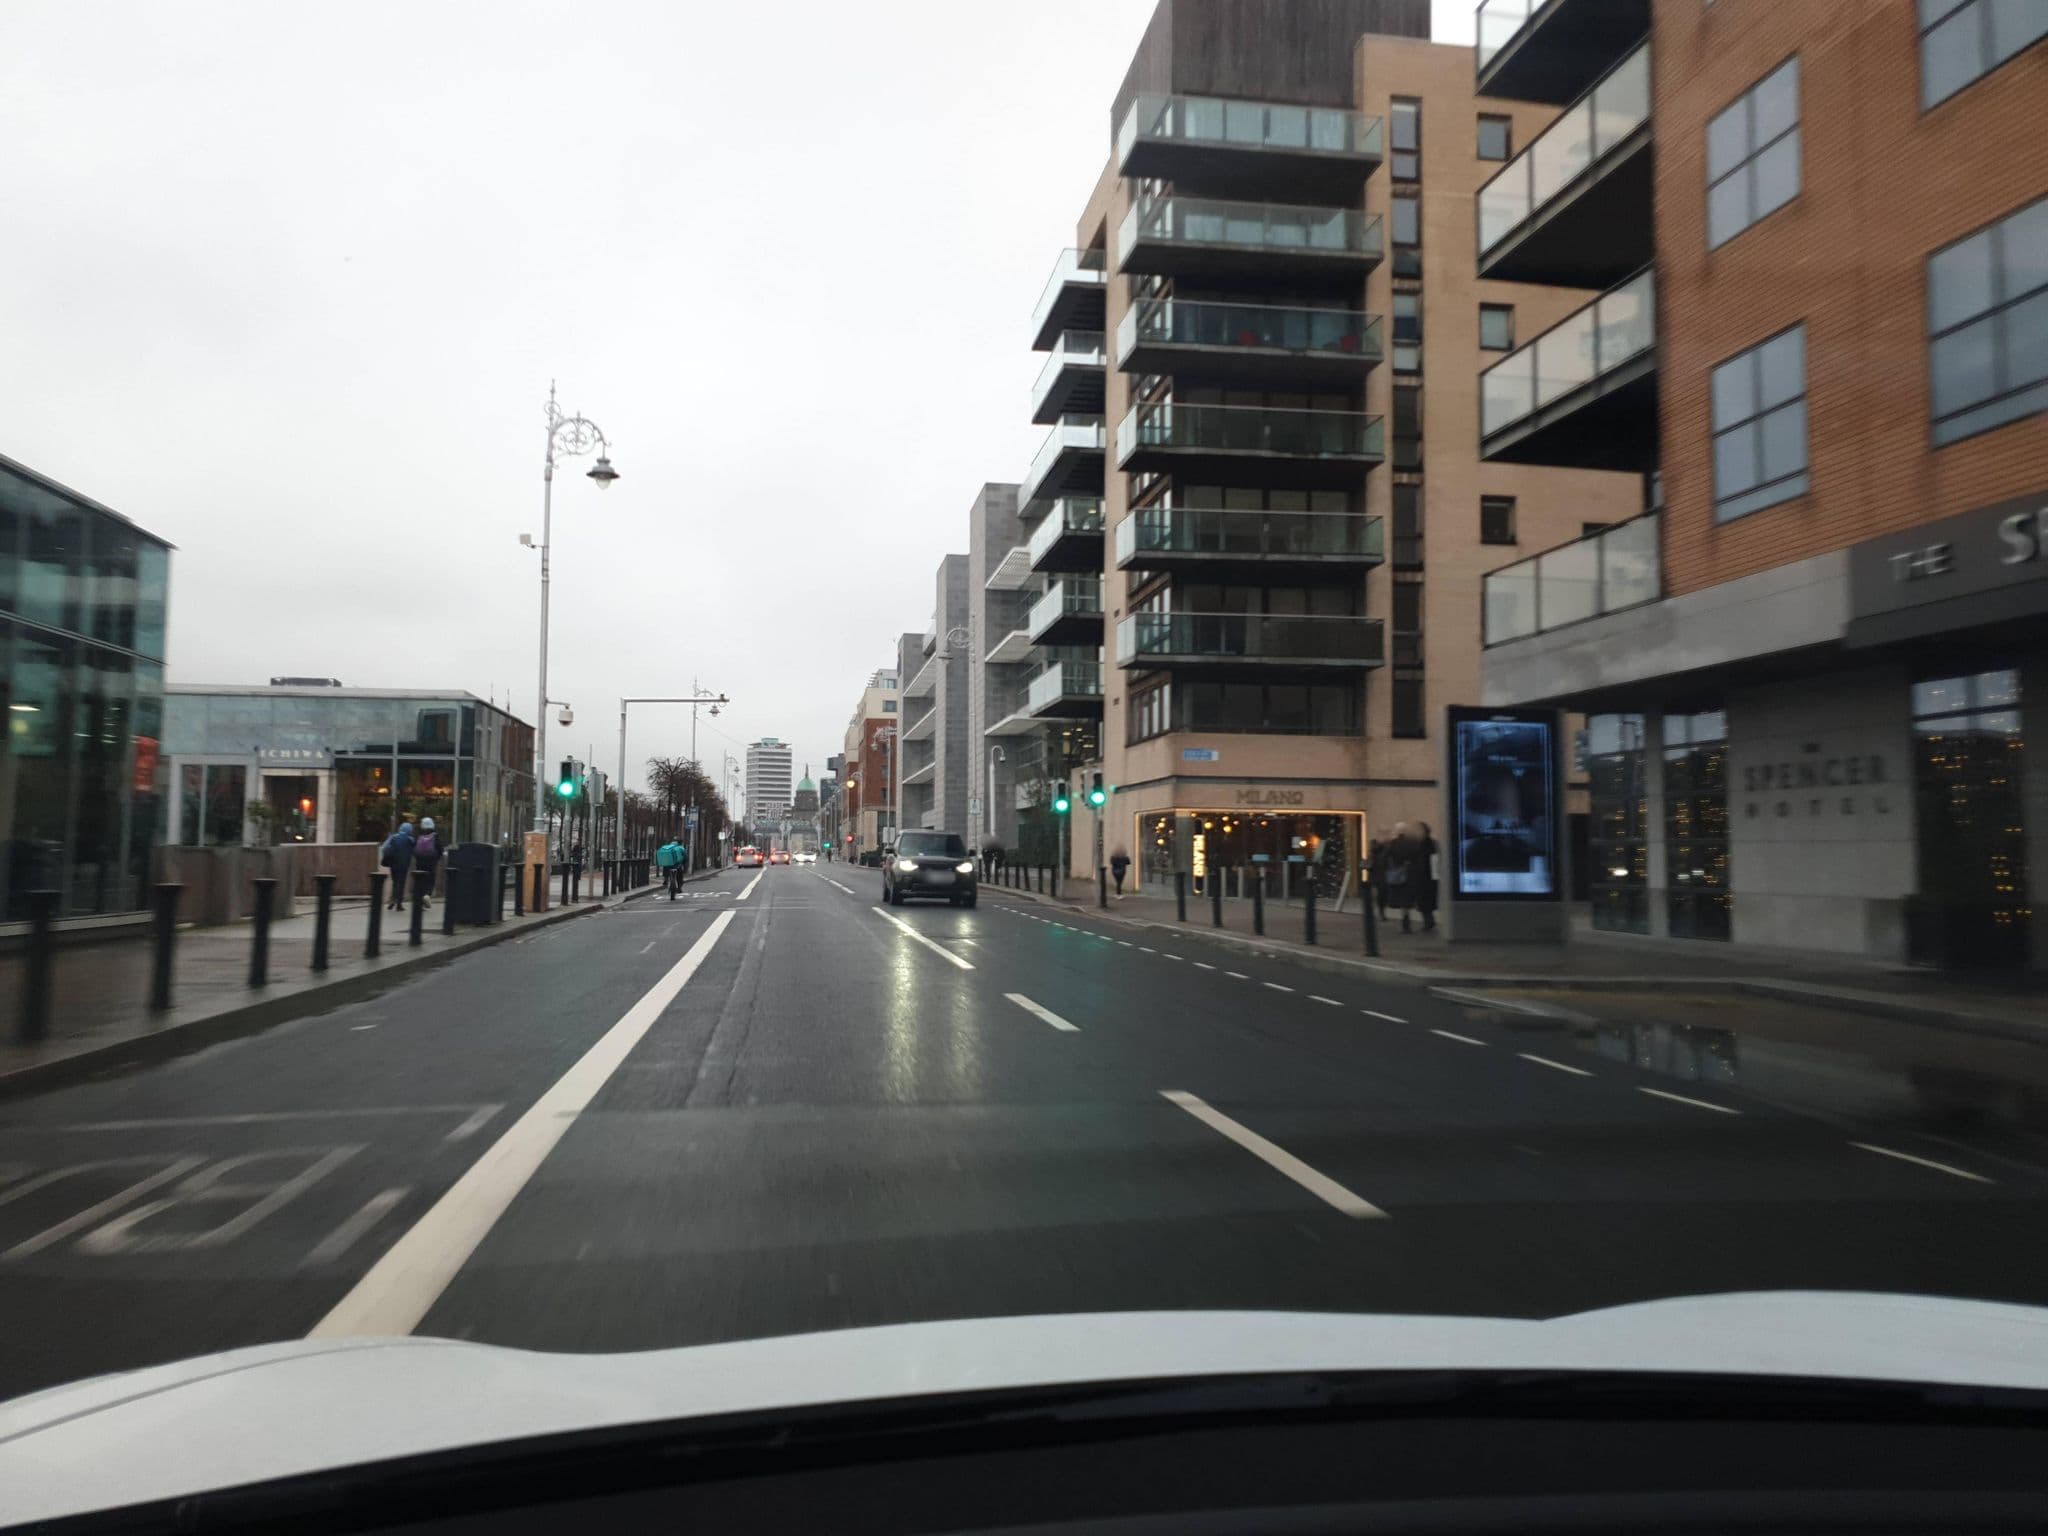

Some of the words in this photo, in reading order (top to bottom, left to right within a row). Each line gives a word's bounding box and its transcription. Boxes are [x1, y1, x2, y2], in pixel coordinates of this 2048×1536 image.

[1887, 543, 1953, 581] THE
[1744, 754, 1886, 792] SPENCER
[1236, 788, 1304, 804] MILANO
[1192, 834, 1206, 877] MILANO
